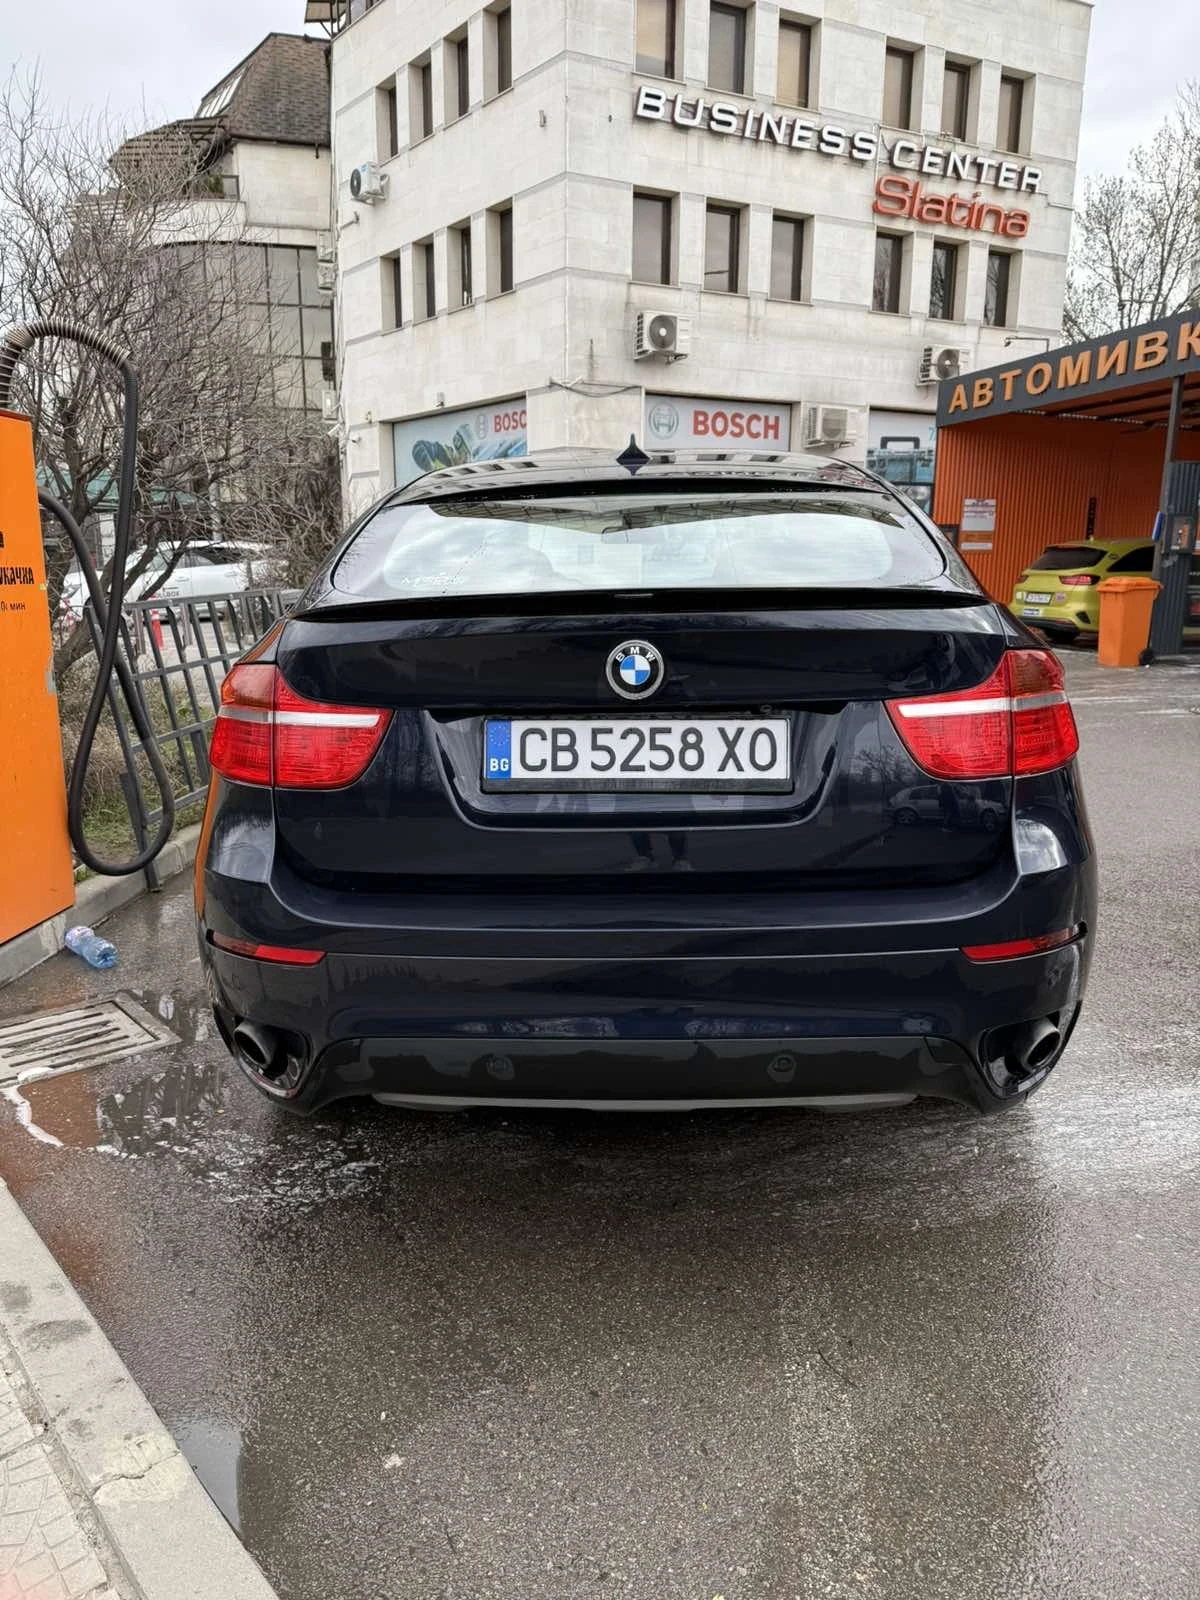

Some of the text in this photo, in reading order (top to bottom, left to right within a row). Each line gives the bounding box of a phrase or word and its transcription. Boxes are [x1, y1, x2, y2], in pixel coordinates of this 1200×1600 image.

[636, 84, 1043, 194] BUSINESS CENTER
[873, 174, 1031, 239] Slatina
[947, 321, 1200, 415] АВТОМИВК
[493, 409, 527, 433] BOSC
[692, 409, 780, 440] BOSCH
[615, 646, 656, 663] BMW
[490, 758, 509, 772] BG
[519, 727, 580, 772] CB
[590, 727, 705, 772] 5258
